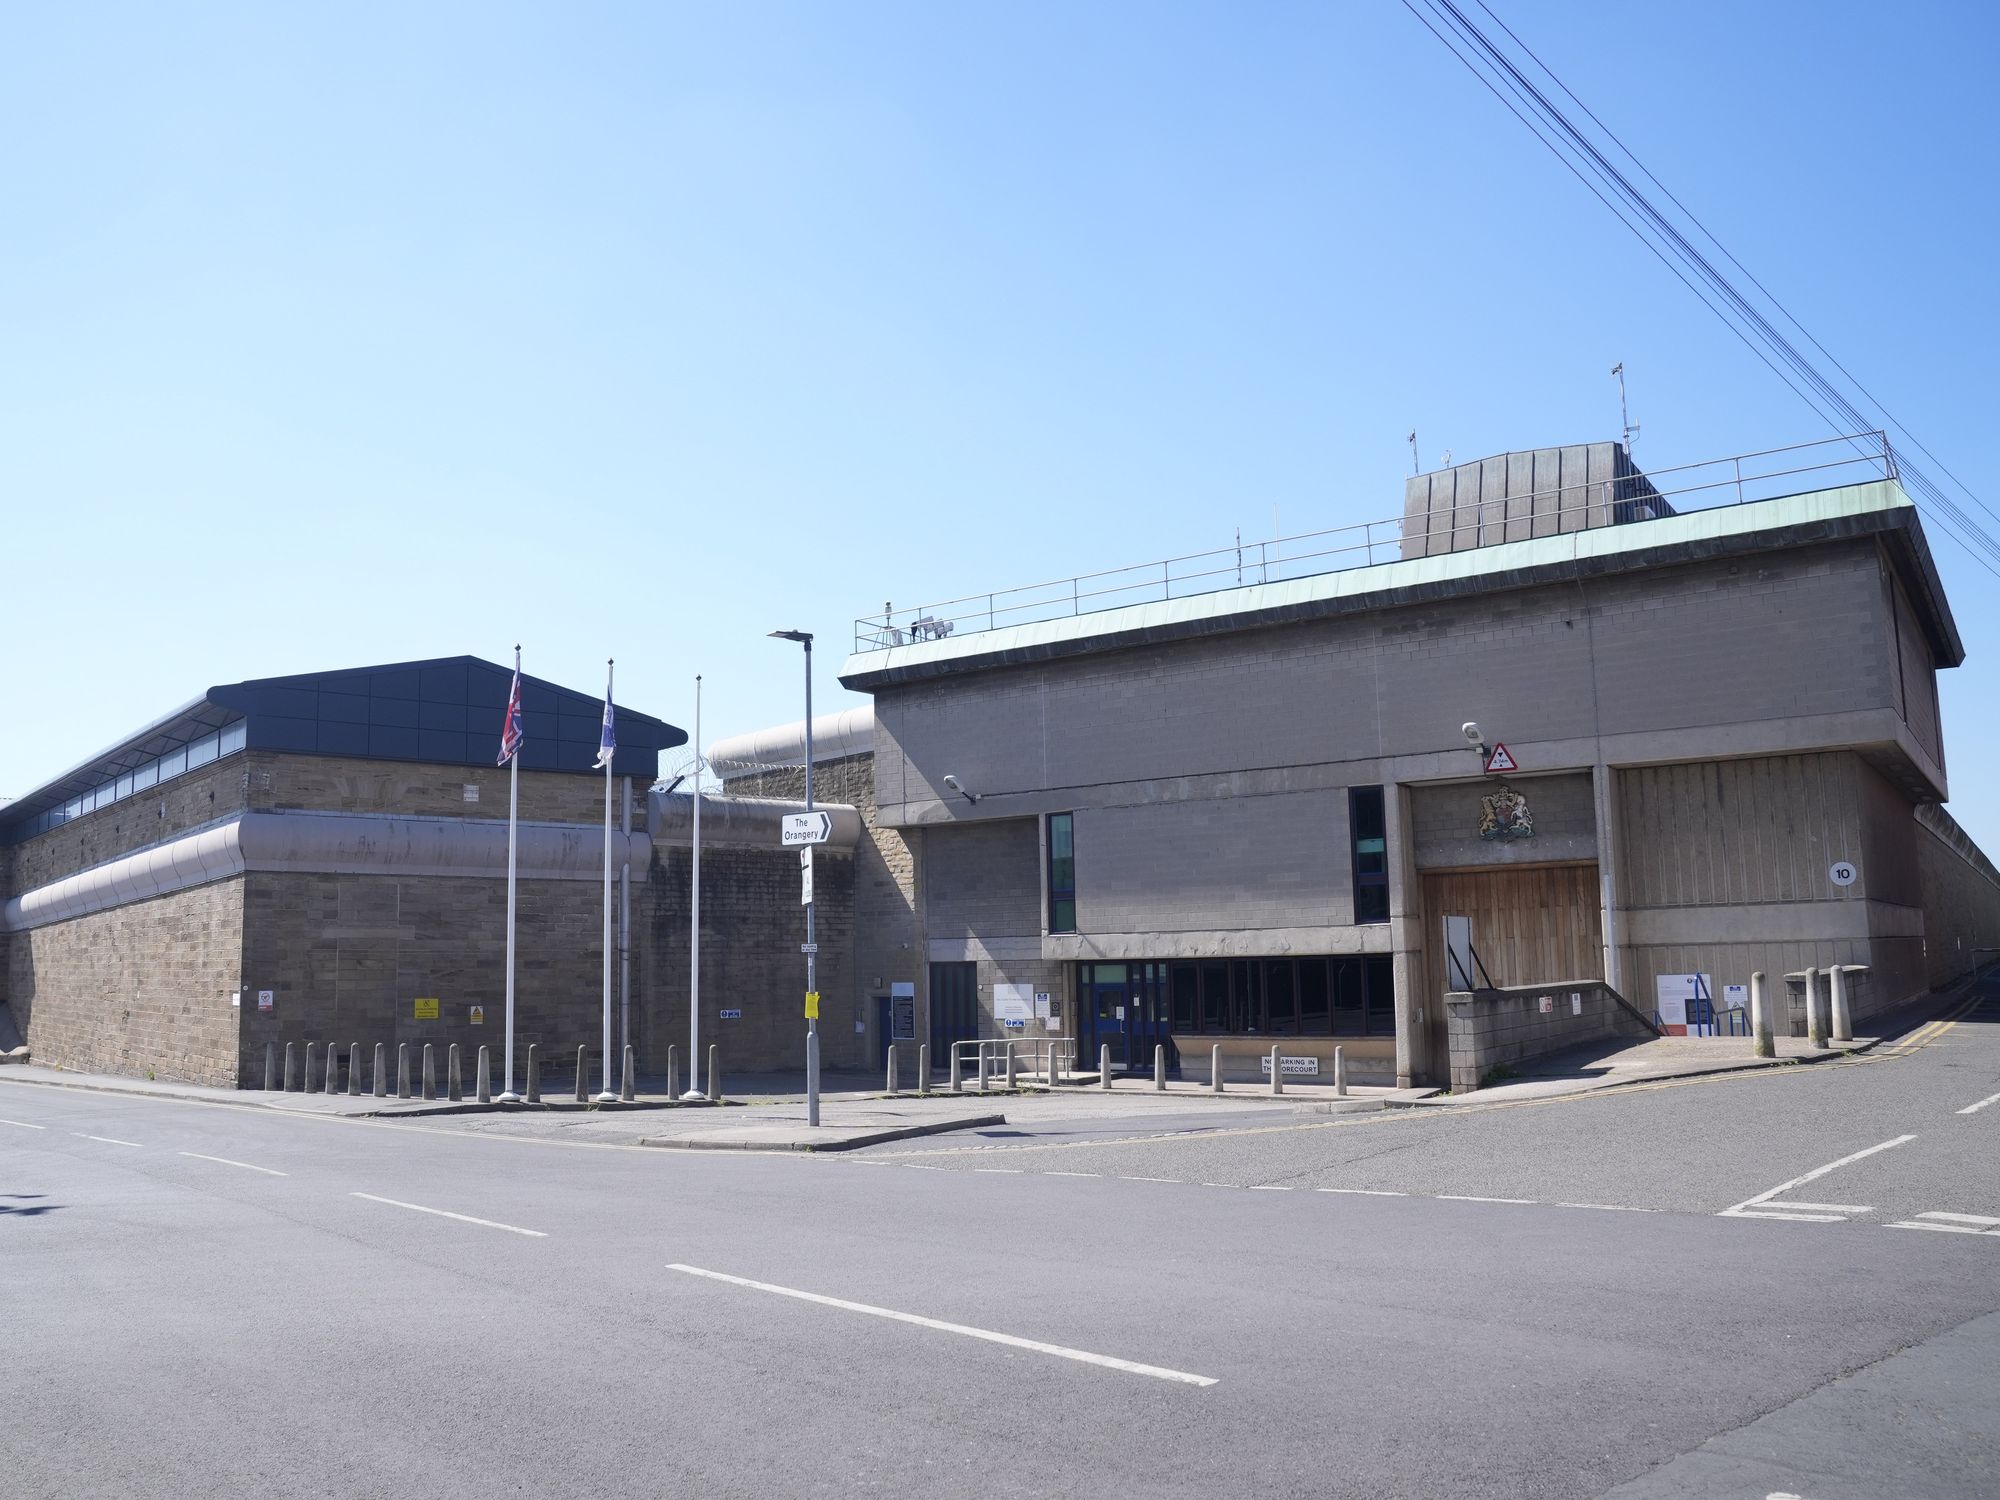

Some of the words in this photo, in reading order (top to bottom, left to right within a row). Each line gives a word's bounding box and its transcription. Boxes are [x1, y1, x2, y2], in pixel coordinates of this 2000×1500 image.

[795, 818, 808, 827] The
[784, 830, 819, 841] Orangery
[1836, 869, 1850, 879] 10
